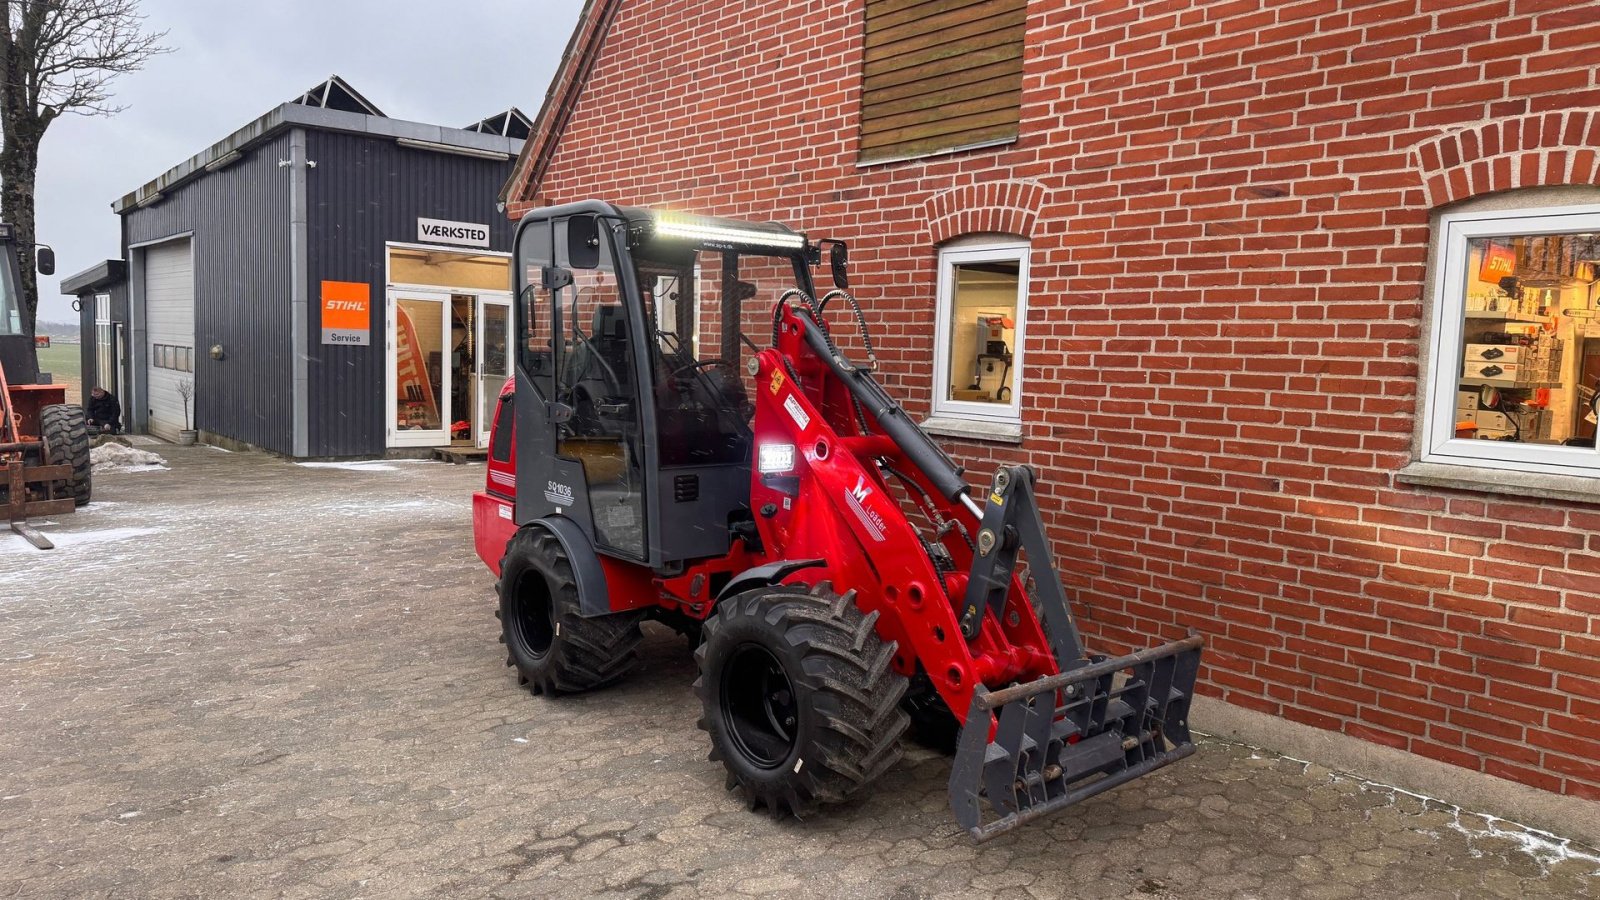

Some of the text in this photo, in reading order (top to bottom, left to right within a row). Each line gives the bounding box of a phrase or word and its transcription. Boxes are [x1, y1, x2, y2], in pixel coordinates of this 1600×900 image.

[421, 223, 486, 241] VÆRKSTED
[1489, 256, 1512, 273] STIHL
[325, 299, 366, 311] STIHL
[331, 332, 361, 343] Service
[866, 504, 887, 532] Loader
